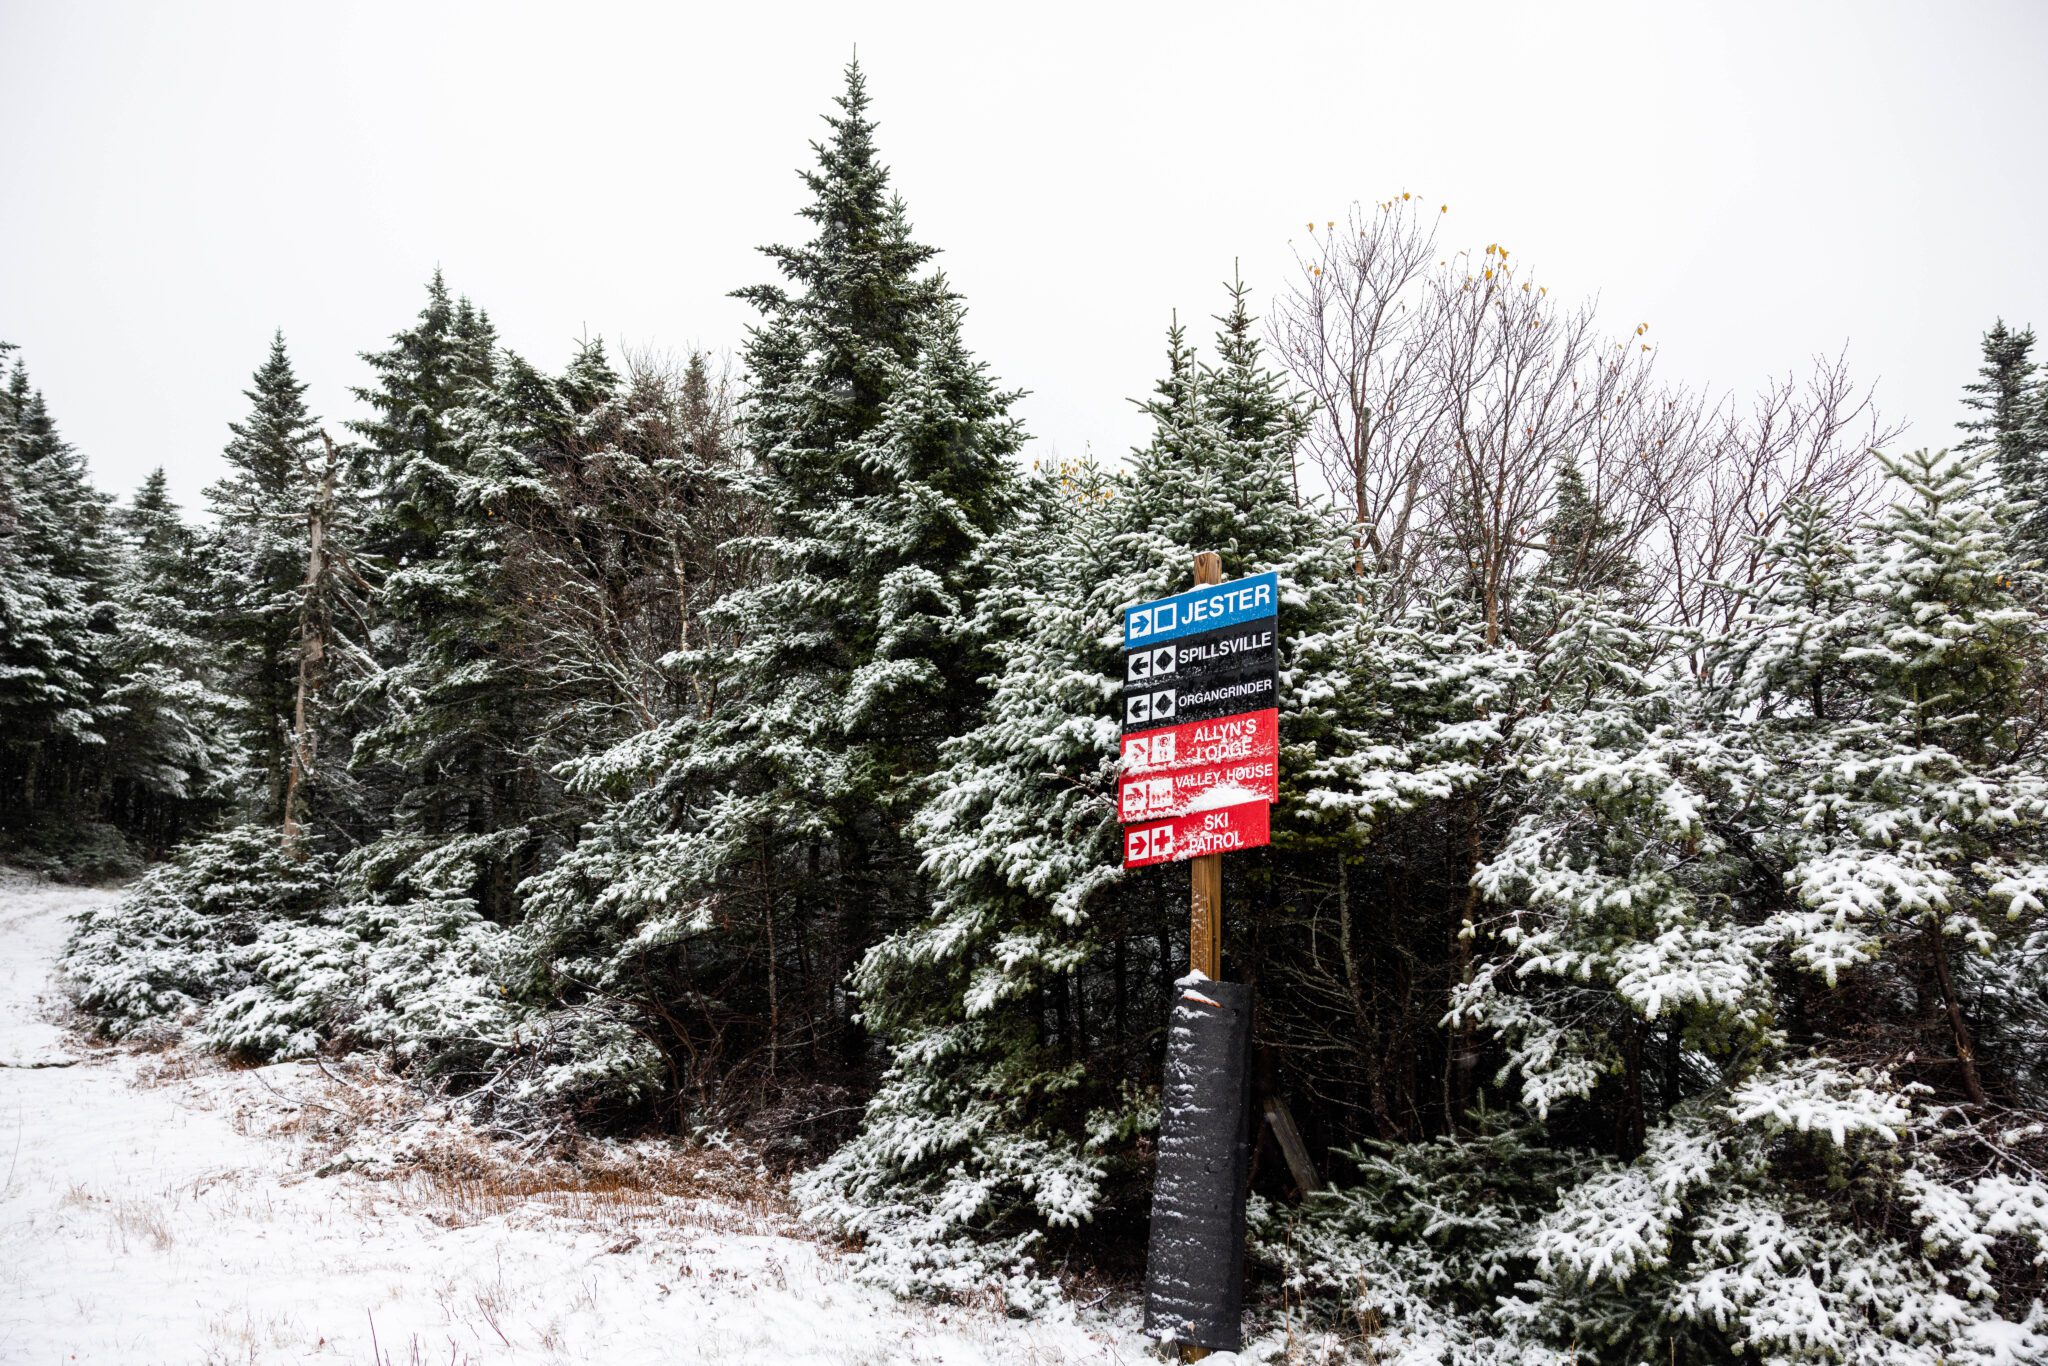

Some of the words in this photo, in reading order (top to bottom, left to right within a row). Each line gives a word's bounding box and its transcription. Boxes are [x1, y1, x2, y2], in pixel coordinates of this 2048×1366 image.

[1181, 583, 1271, 625] JESTER
[1178, 631, 1272, 664] SPILLSVILLE
[1178, 679, 1273, 707] ORGANGRINDER
[1193, 718, 1257, 743] ALLYN'S
[1196, 739, 1252, 762] LODGE
[1175, 771, 1221, 789] VALLEY
[1226, 763, 1273, 783] HOUSE
[1204, 811, 1229, 831] SKI
[1189, 831, 1244, 852] PATROL
